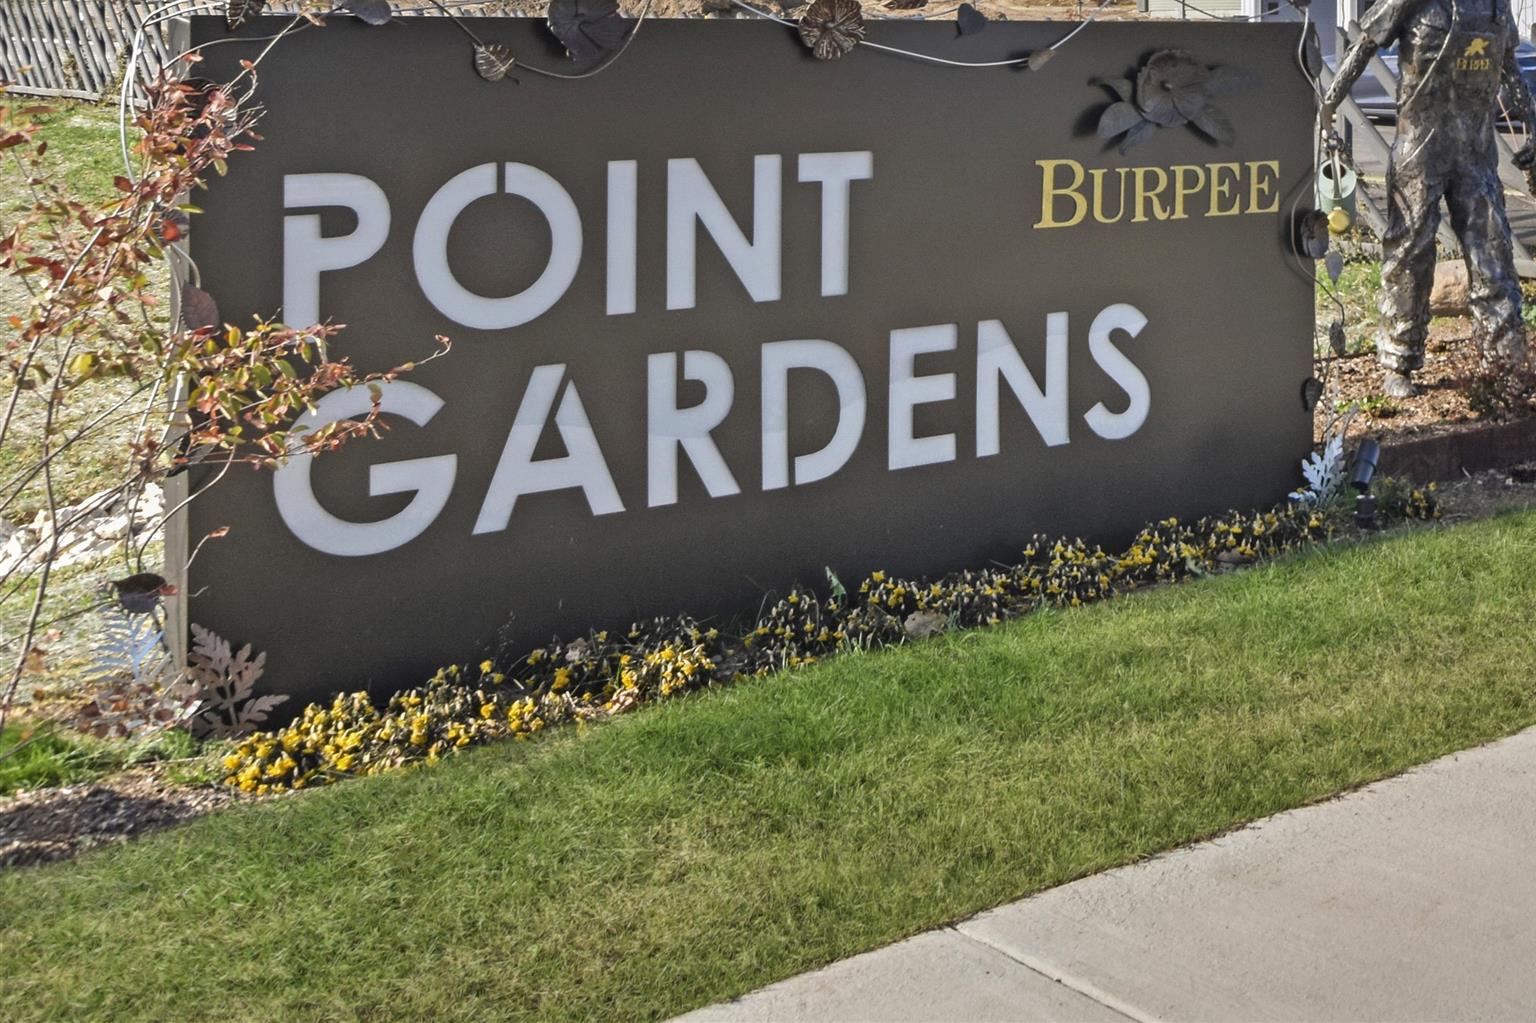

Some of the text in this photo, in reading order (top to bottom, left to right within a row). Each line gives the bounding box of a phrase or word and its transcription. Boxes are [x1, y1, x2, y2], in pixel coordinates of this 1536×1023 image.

[284, 151, 873, 343] POINT
[1033, 159, 1280, 229] BURPEE
[274, 303, 1151, 556] GARDENS
